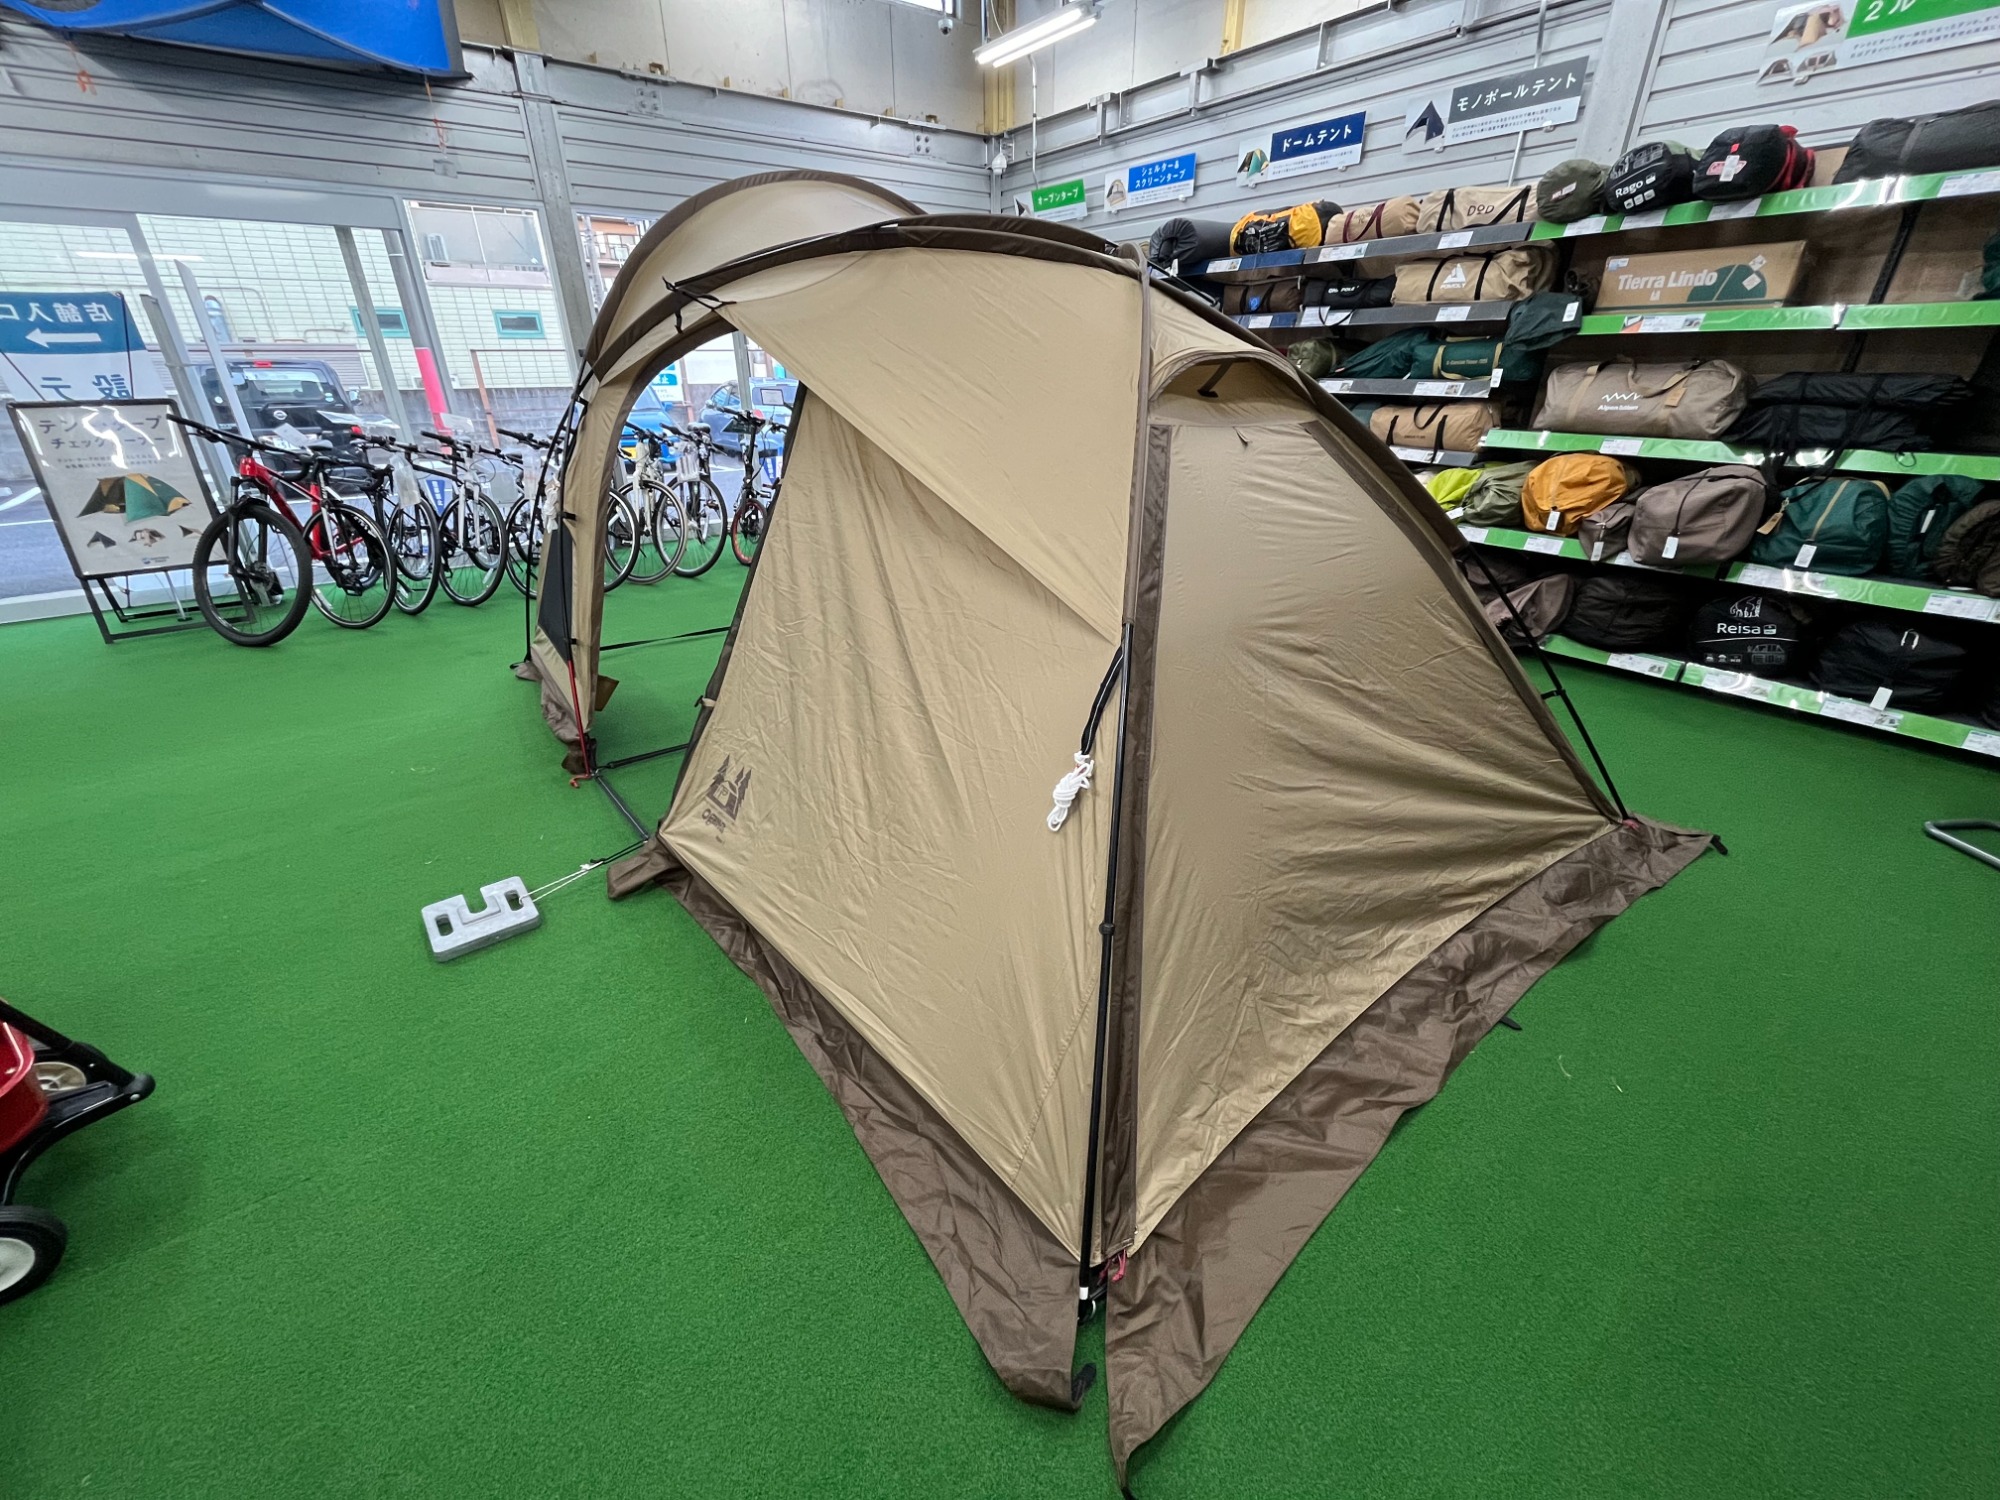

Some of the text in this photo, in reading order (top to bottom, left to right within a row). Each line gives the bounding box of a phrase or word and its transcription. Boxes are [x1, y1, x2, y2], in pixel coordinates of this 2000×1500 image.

[1457, 72, 1577, 112] モノポールテント
[1282, 124, 1352, 152] ドームテント
[1615, 179, 1644, 199] Rago
[1618, 269, 1718, 291] Tierra Lindo
[51, 436, 165, 449] チェックーナー
[1716, 623, 1760, 634] Reisa
